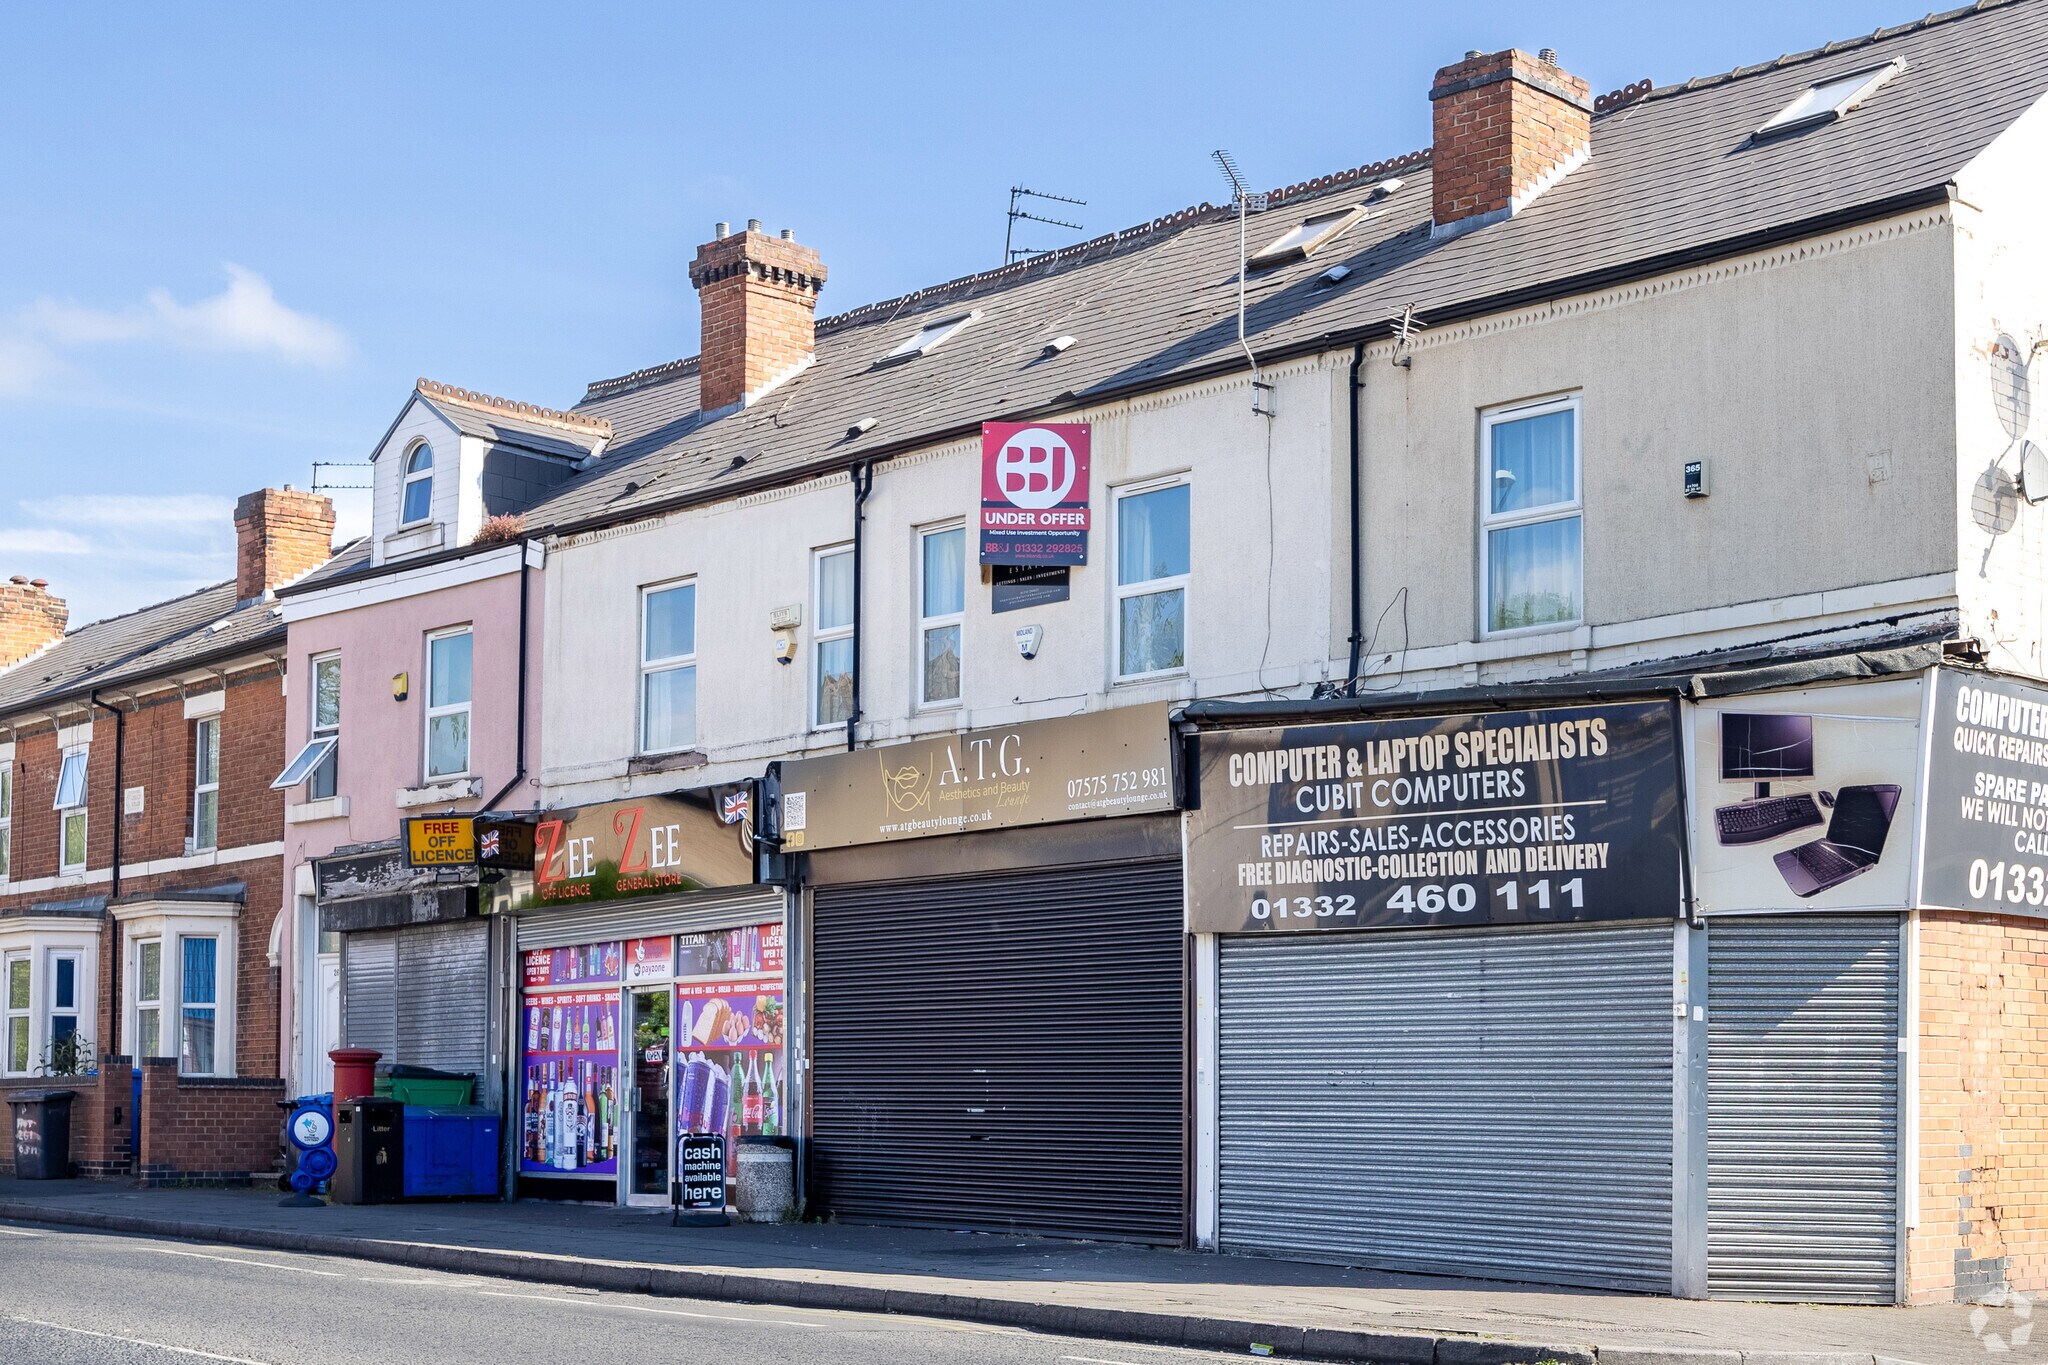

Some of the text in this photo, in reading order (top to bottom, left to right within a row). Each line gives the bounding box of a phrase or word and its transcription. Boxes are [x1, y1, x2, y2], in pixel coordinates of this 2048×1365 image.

[1685, 464, 1701, 473] 365
[985, 512, 1086, 525] UNDER OFFER
[1014, 543, 1044, 553] 01332
[1046, 544, 1084, 553] 292825
[1229, 717, 1608, 787] COMPUTER & LAPTOP SPECIALISTS
[1954, 726, 2048, 768] QUICK REPAIRS
[939, 734, 1031, 786] A.T.G.
[938, 780, 1031, 802] Aesthetics and Beauty
[1067, 766, 1168, 799] 07575 752 981
[1295, 768, 1526, 813] CUBIT COMPUTERS
[1974, 771, 2028, 804] SPARE
[1067, 789, 1168, 811] contact@atgbeautylounge.co.uk
[879, 809, 993, 833] www.atgbeautylounge.co.uk
[1961, 796, 2048, 831] WE WILL NO
[423, 822, 460, 835] FREE
[1261, 814, 1576, 858] REPAIRS-SALES-ACCESSORIES
[428, 835, 456, 848] OFF
[534, 805, 682, 884] ZEE ZEE
[412, 848, 474, 862] LICENCE
[1238, 842, 1610, 887] FREE DIAGNOSTIC-COLLECTION AND DELIVERY
[616, 872, 682, 892] GENERAL STORE
[1968, 858, 2048, 906] 0133
[541, 883, 591, 901] OFF LICENCE
[1251, 877, 1584, 919] 01332 460 111
[680, 934, 706, 946] TITAN
[525, 954, 551, 967] LICENCE
[763, 948, 776, 959] OPEN
[526, 967, 537, 976] OPEN
[540, 965, 550, 975] DAYS
[641, 964, 666, 977] payzone
[679, 986, 691, 995] FRUIT
[695, 985, 703, 994] VEG
[705, 985, 715, 993] MILK
[718, 985, 731, 993] BREAD
[733, 983, 757, 993] HOUSEHOLD
[525, 997, 538, 1006] BEERS
[540, 996, 554, 1005] WINES
[556, 994, 572, 1004] SPIRITS
[575, 994, 586, 1003] SOFT
[586, 994, 601, 1003] DRINKS
[646, 1051, 662, 1062] OPEN
[684, 1143, 722, 1160] cash
[684, 1161, 722, 1171] machine
[684, 1172, 722, 1182] available
[684, 1183, 722, 1200] here
